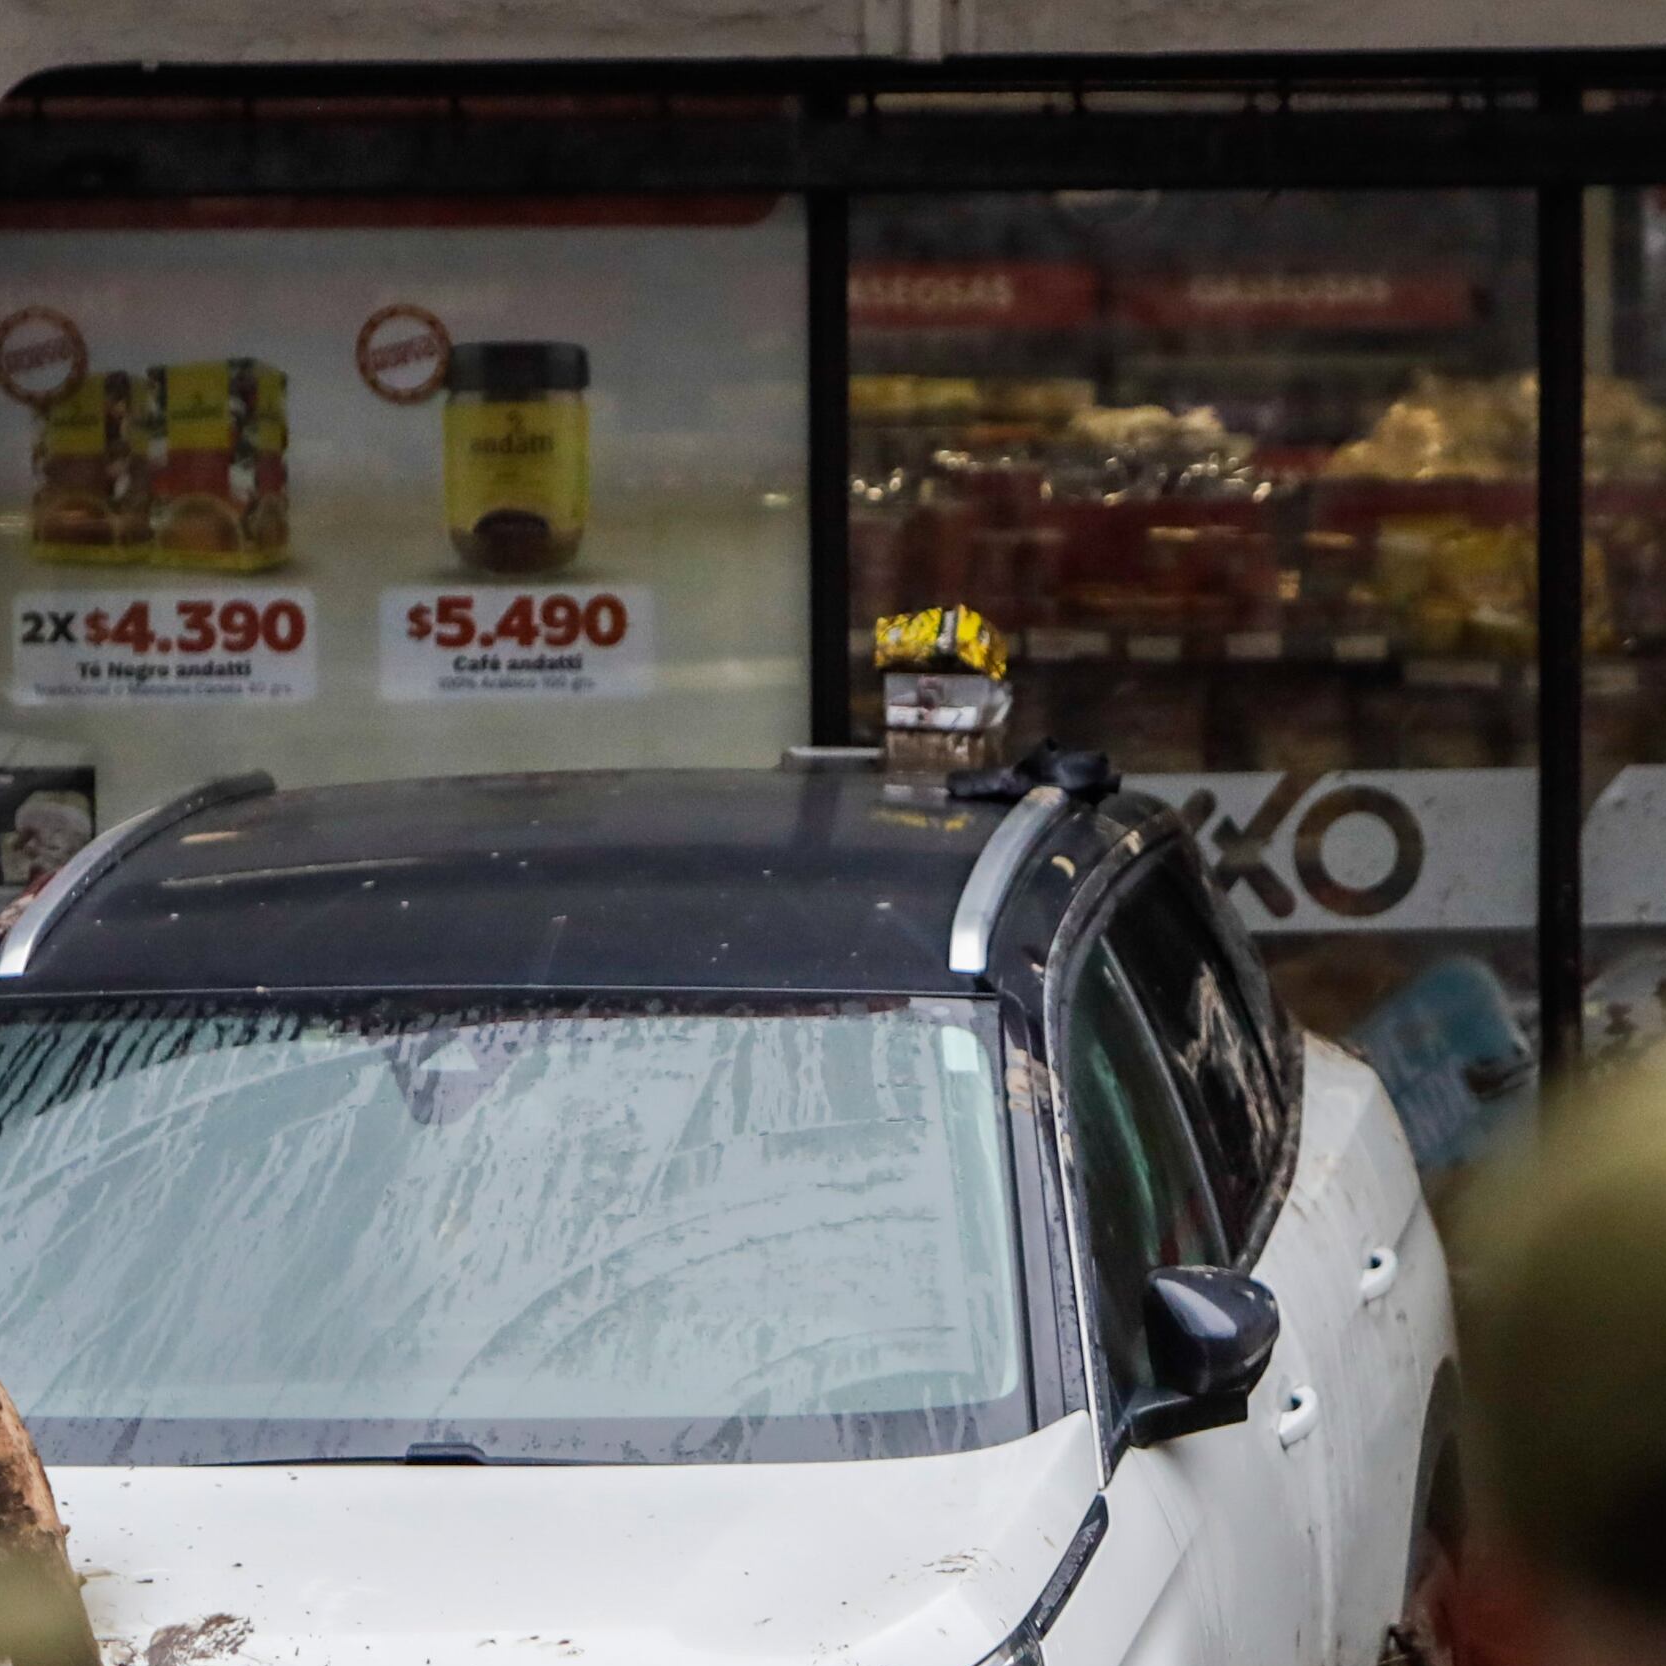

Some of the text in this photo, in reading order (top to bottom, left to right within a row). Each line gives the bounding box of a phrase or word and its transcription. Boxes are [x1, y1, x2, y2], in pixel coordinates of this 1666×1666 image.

[21, 599, 306, 654] 2X $4.390
[406, 593, 629, 648] $5.490
[1183, 770, 1425, 918] XO
